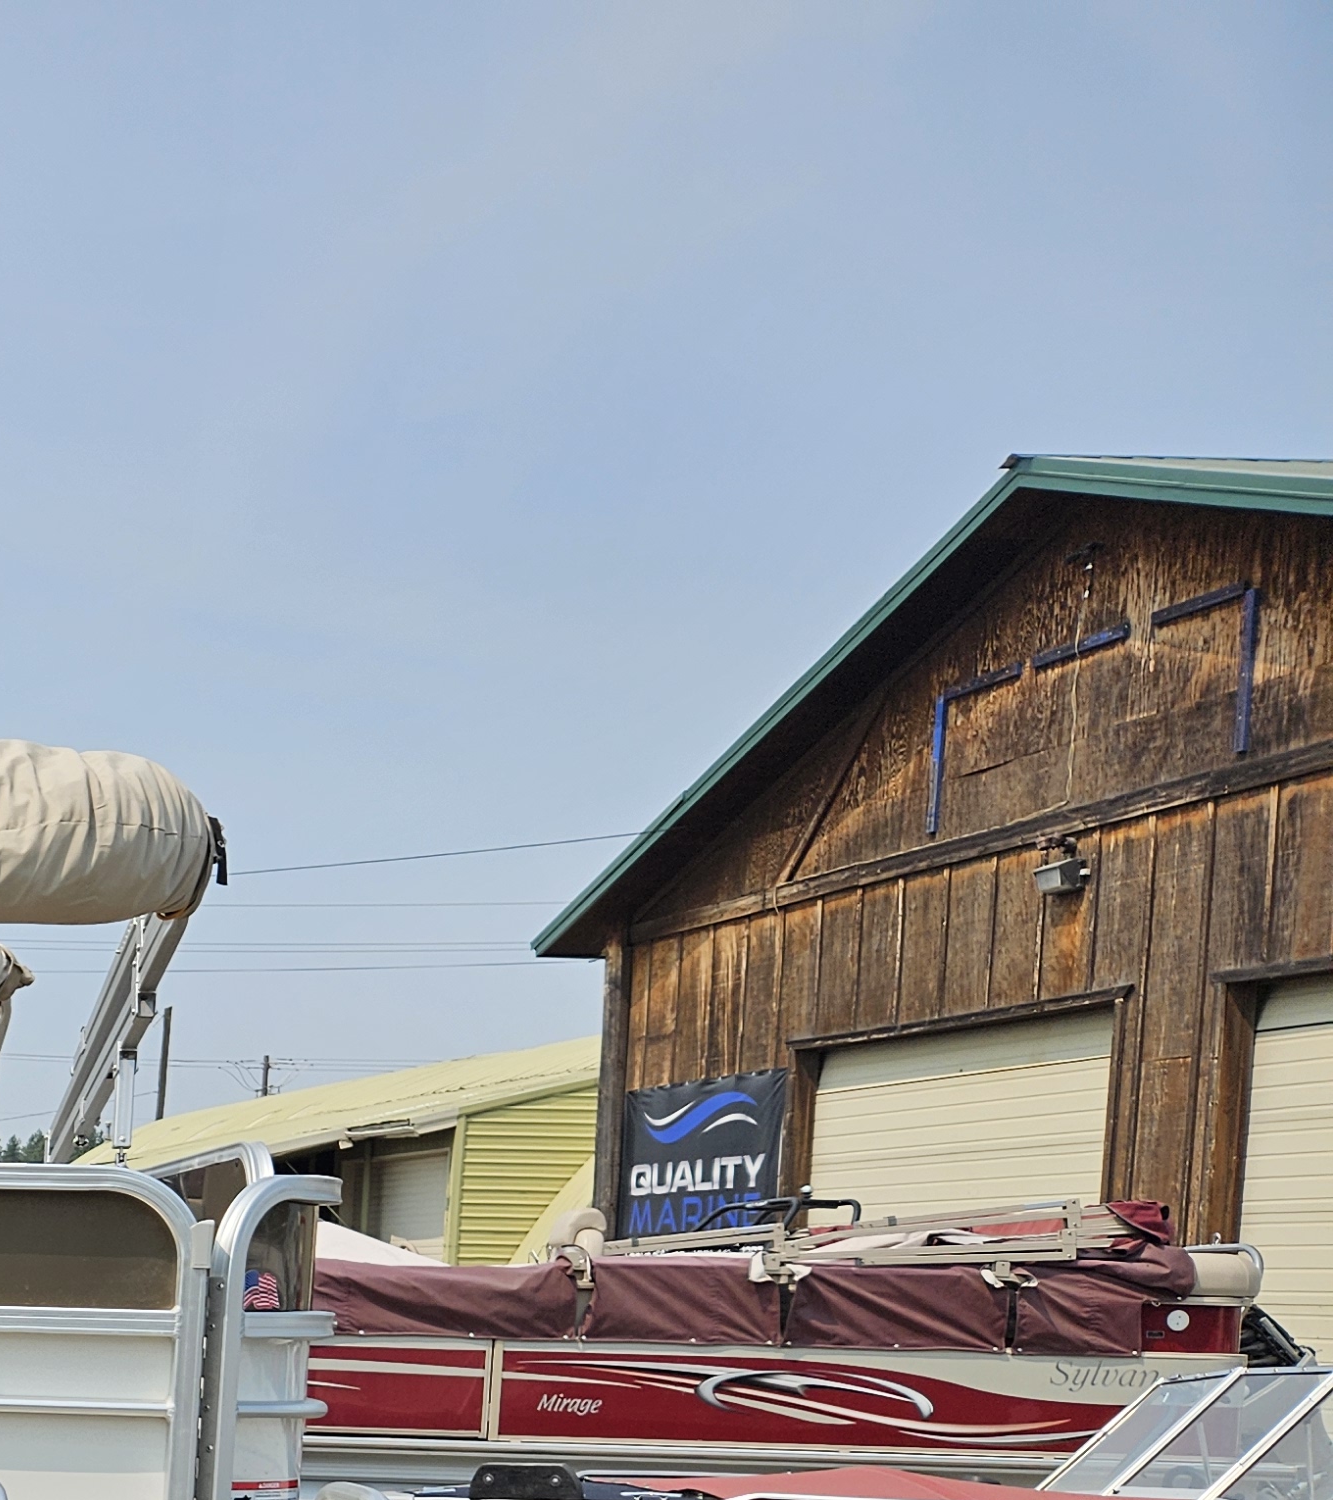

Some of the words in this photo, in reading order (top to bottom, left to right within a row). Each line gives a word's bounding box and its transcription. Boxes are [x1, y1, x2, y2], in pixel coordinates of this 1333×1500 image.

[630, 1153, 766, 1196] QUALITY
[1049, 1360, 1160, 1392] Sylvan
[536, 1393, 603, 1416] Mirage
